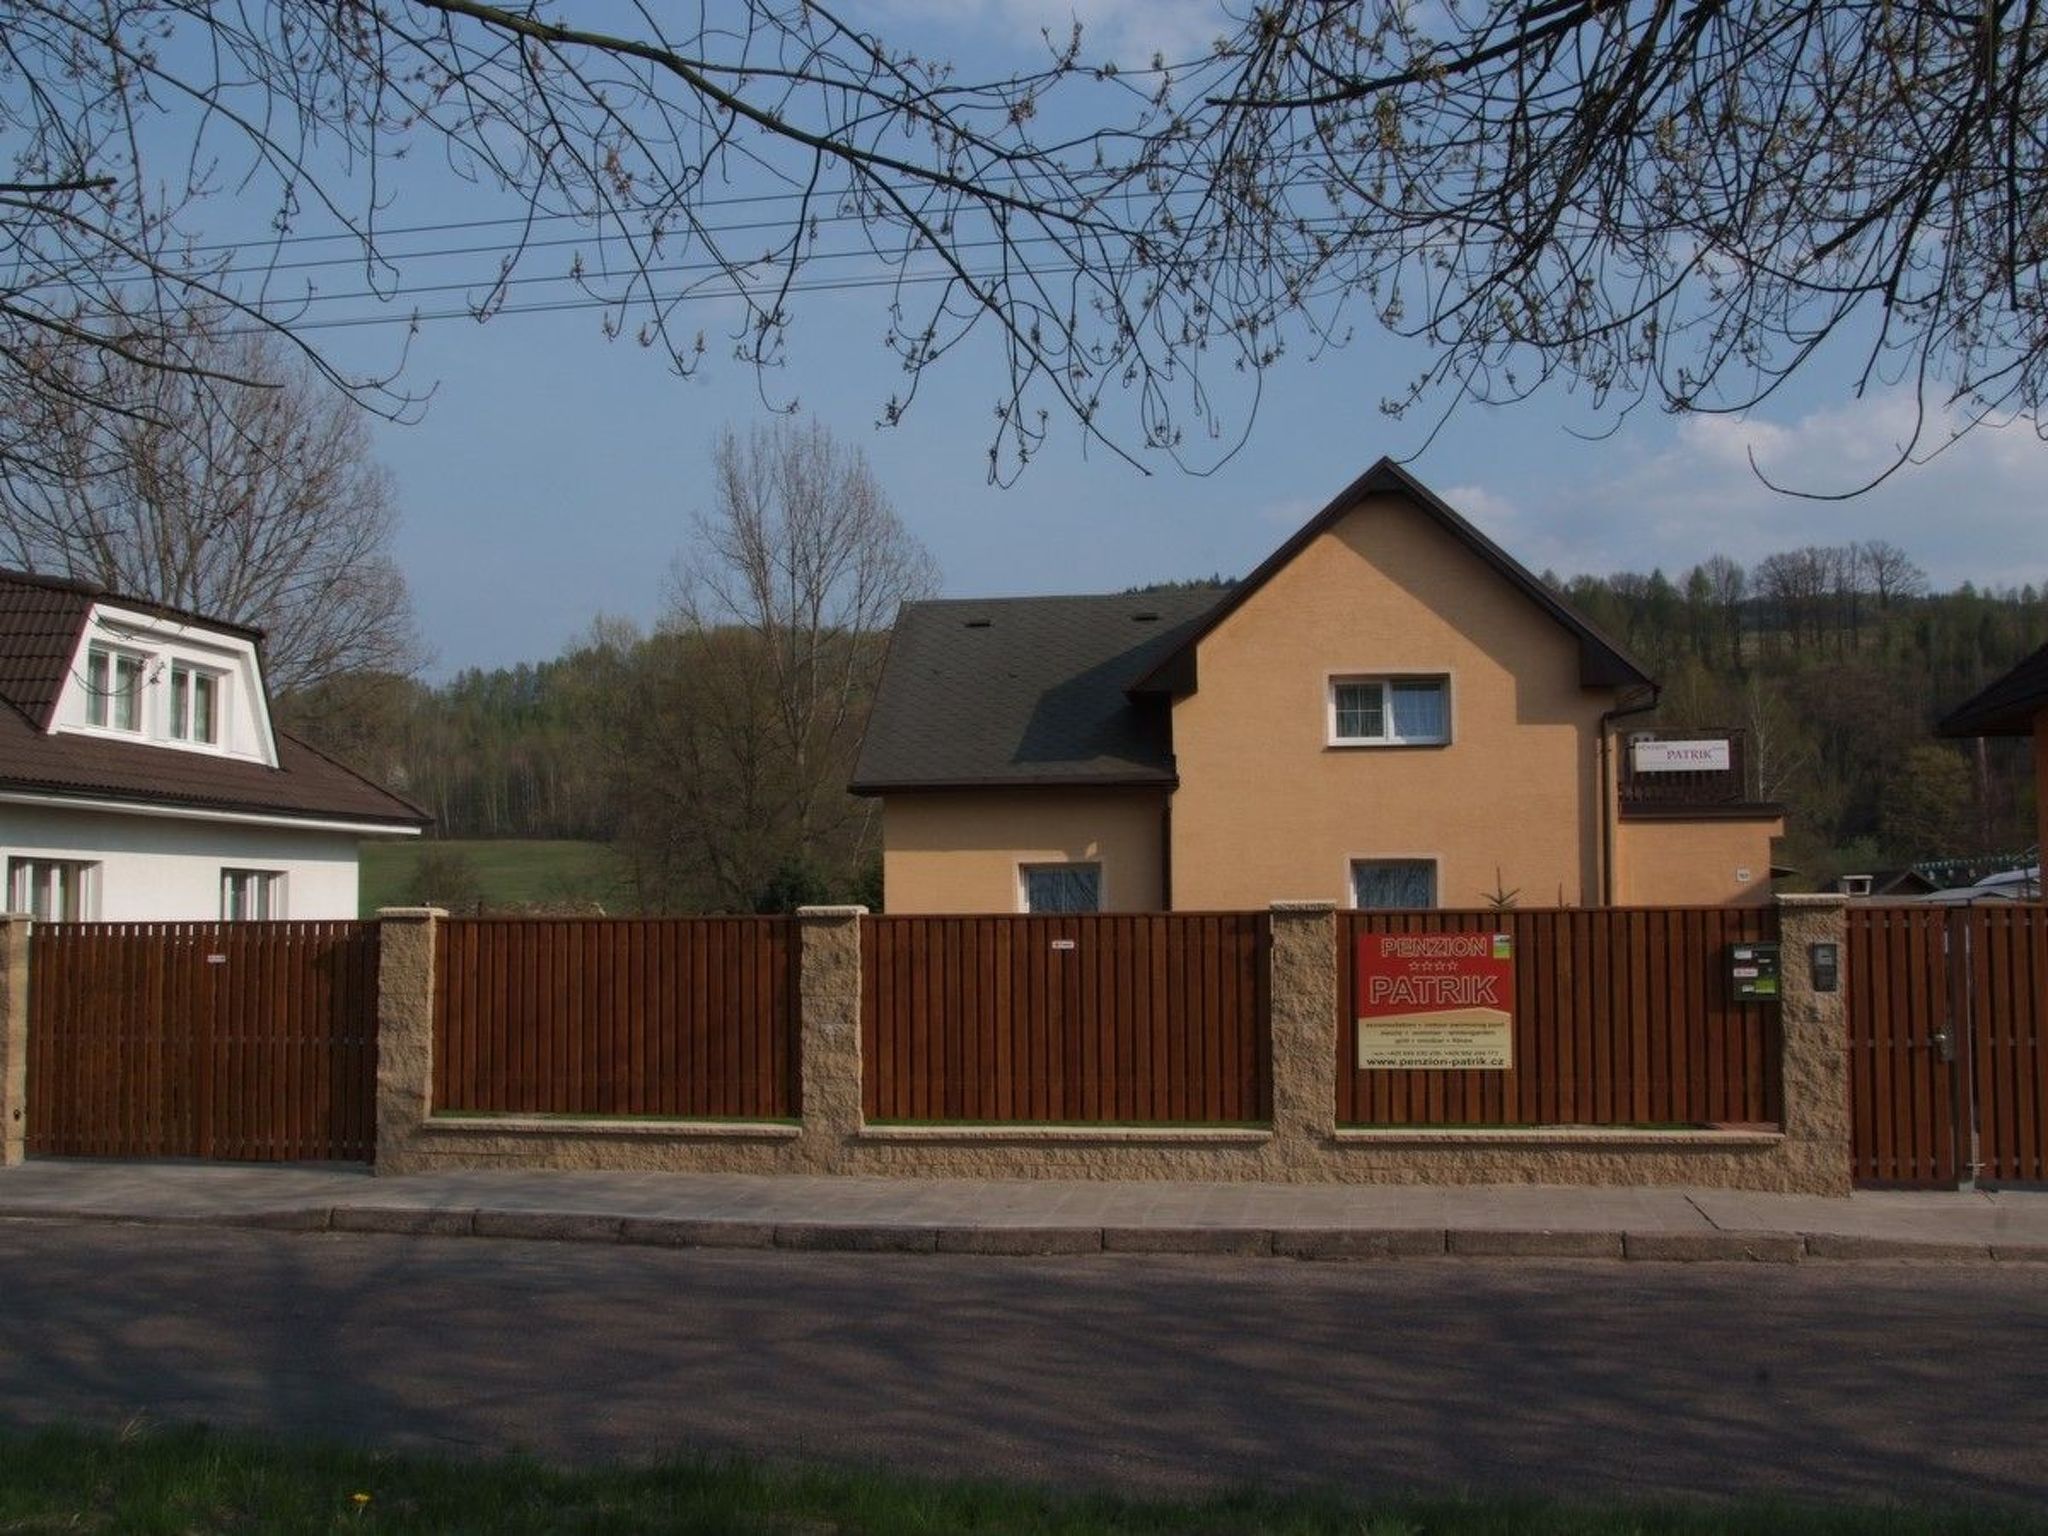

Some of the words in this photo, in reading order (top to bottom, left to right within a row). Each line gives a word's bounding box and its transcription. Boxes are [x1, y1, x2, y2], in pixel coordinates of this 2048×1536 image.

[1666, 750, 1711, 760] PATRIK
[1381, 936, 1487, 958] PENZION
[1369, 975, 1500, 1005] PATRIK
[1366, 1056, 1505, 1067] www.penzion-patrik.cz
